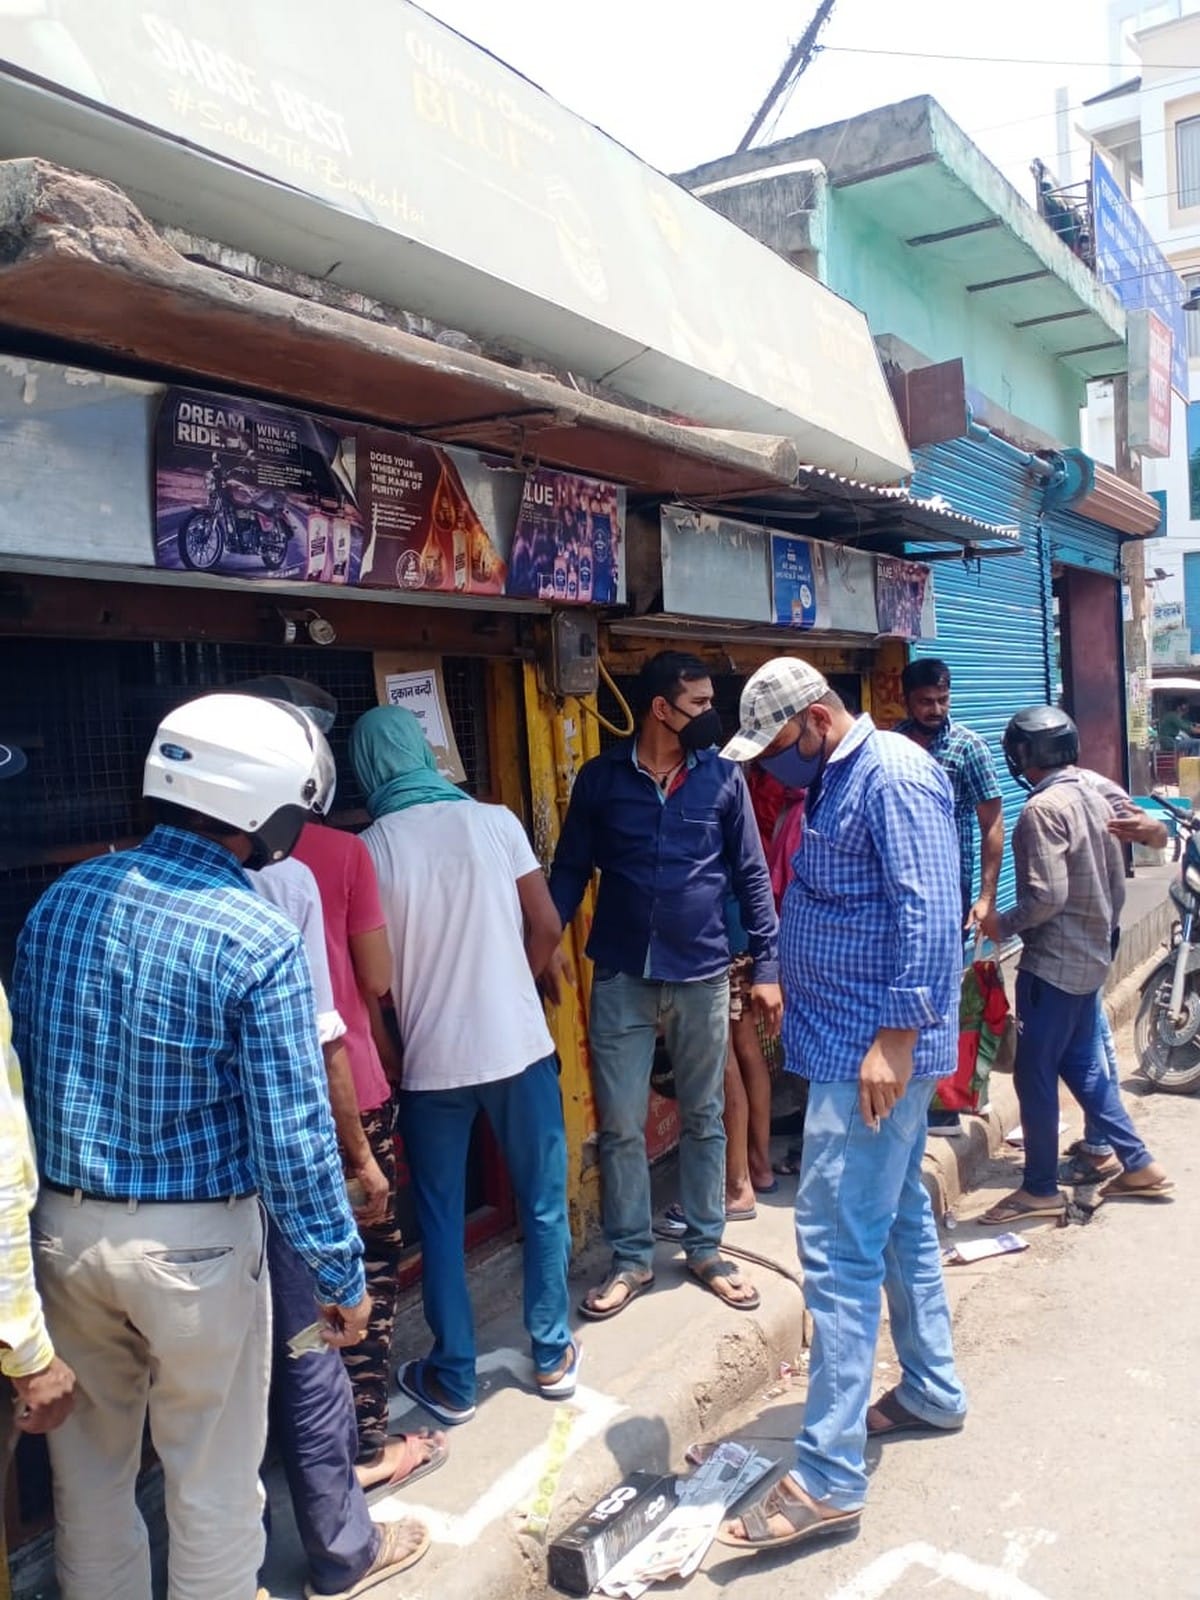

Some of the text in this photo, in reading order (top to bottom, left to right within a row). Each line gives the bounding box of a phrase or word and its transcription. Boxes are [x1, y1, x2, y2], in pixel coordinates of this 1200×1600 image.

[270, 79, 353, 158] BEST
[256, 423, 297, 442] WIN 45
[370, 451, 414, 468] DOES YOUR
[370, 462, 423, 481] WHISKY HAVE
[371, 473, 422, 490] THE MARK OF
[371, 483, 404, 497] PURITY?
[390, 686, 414, 705] दुकान
